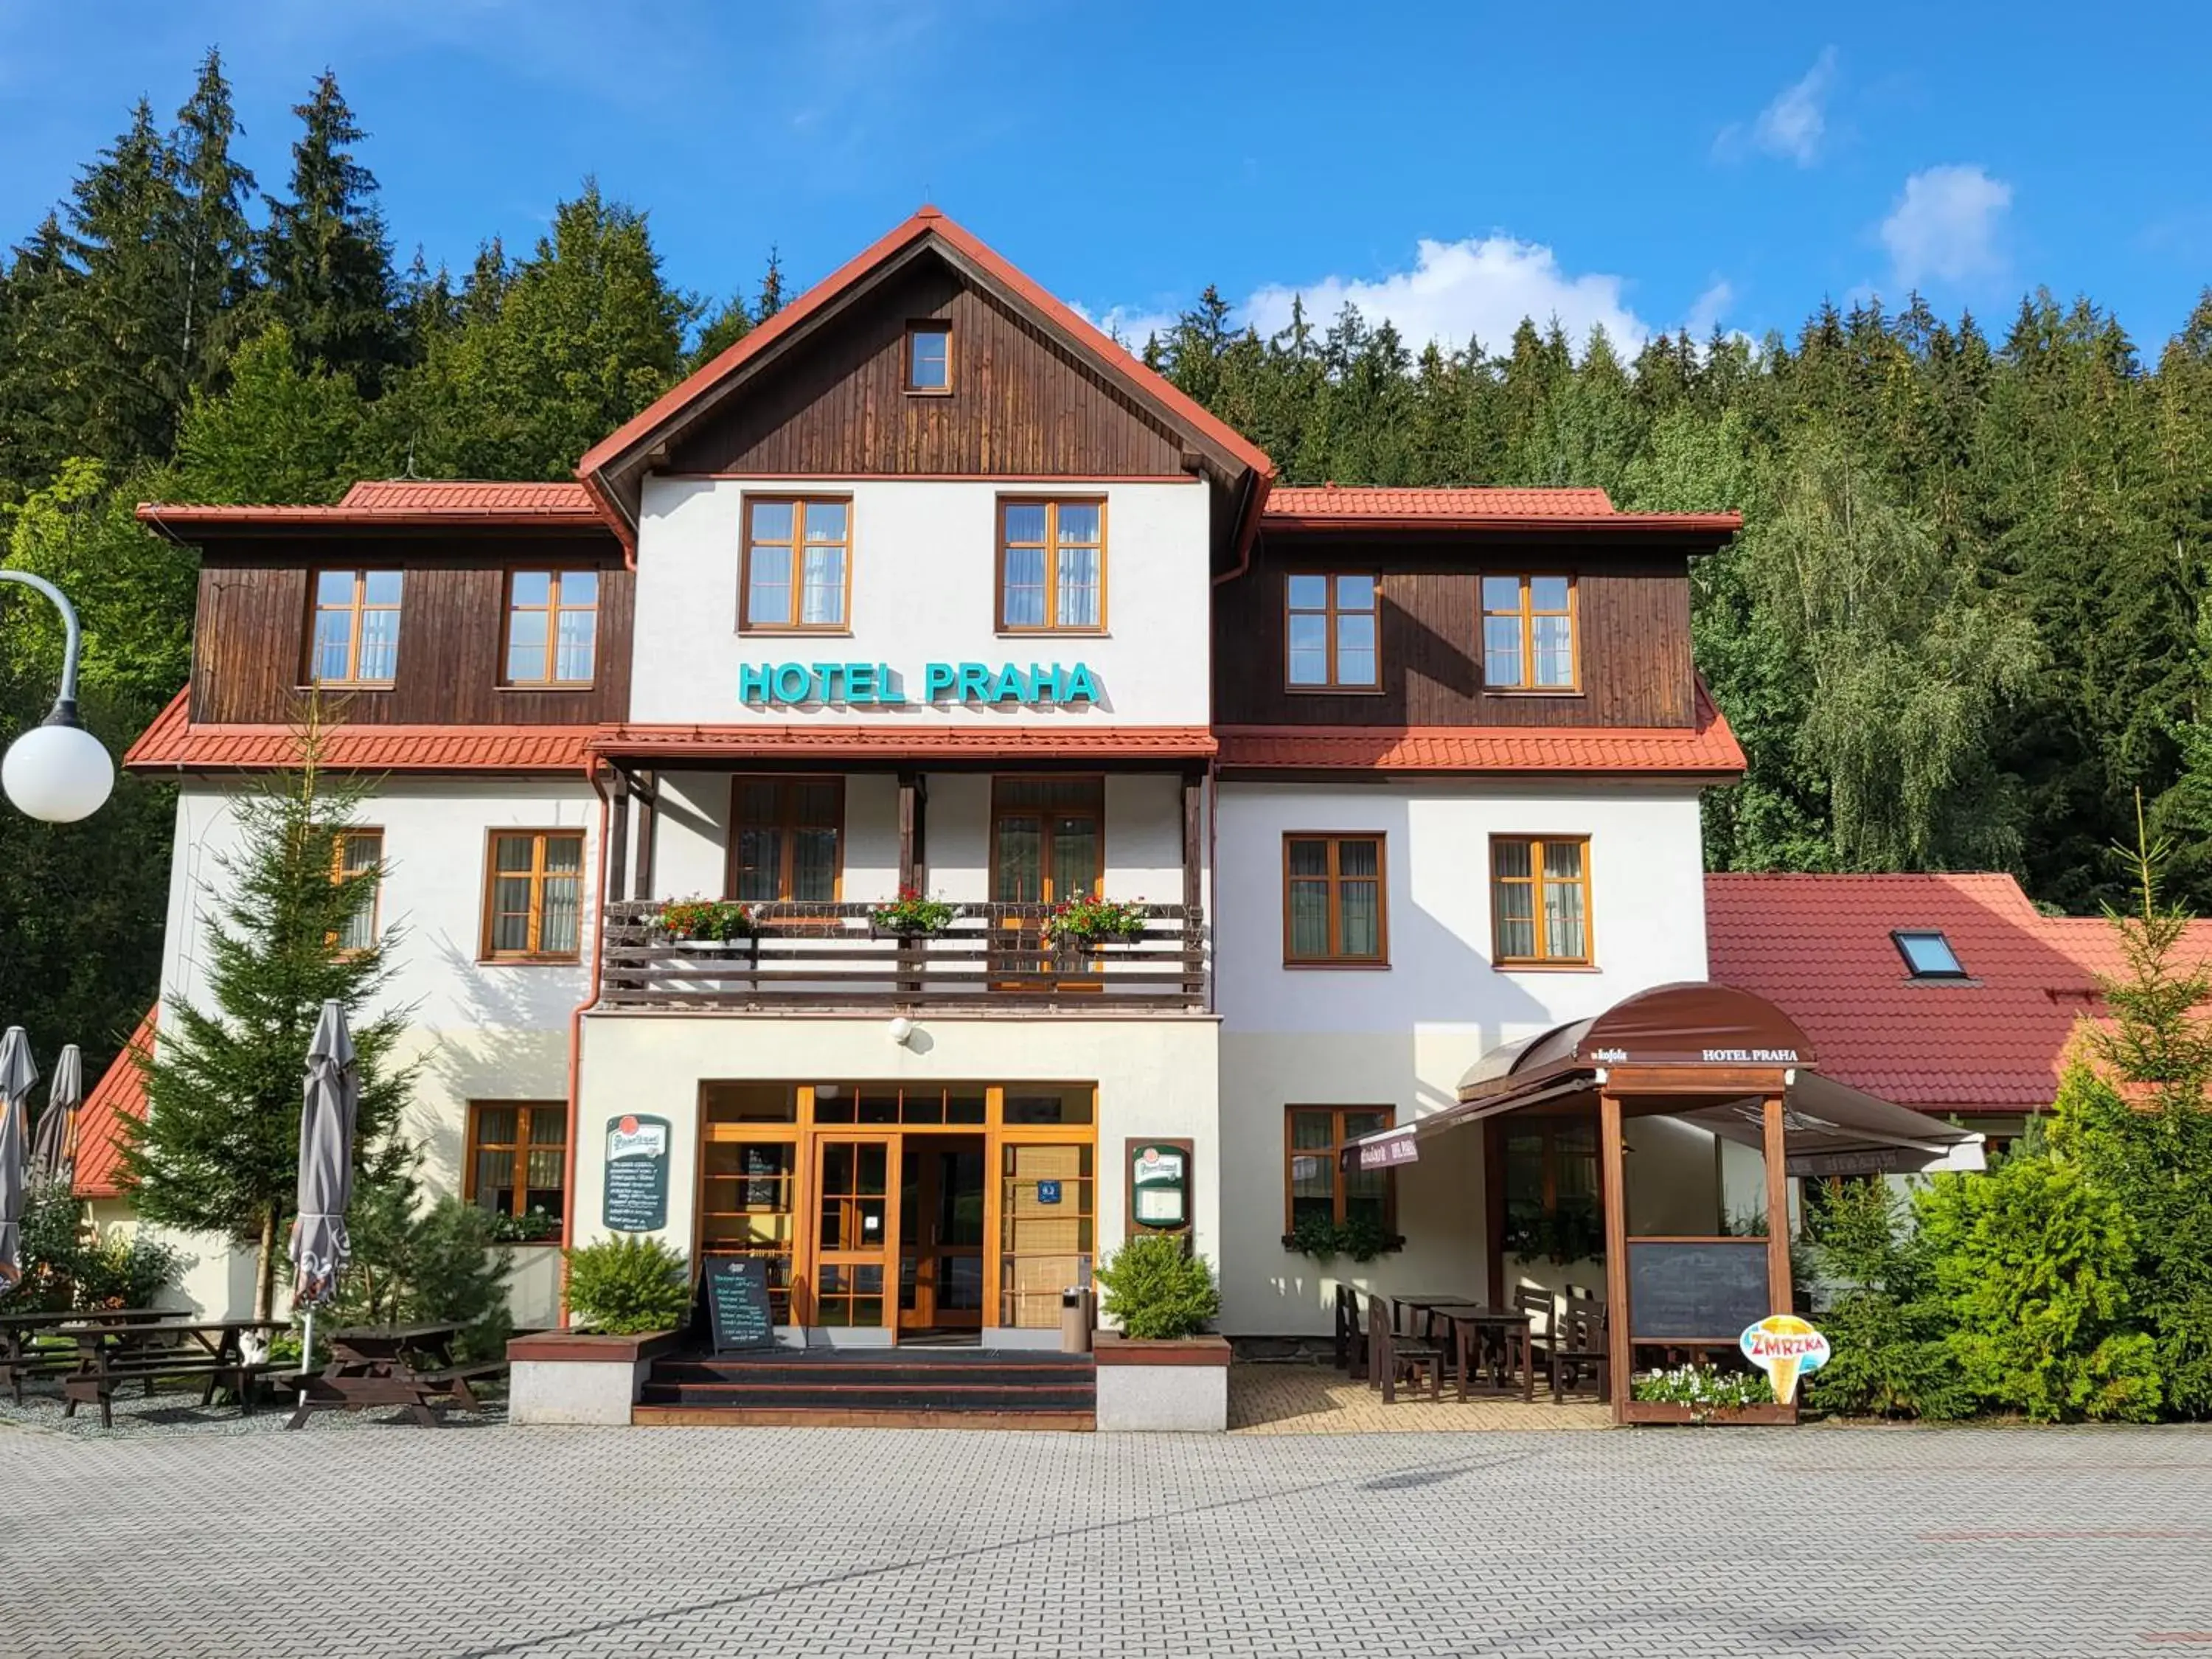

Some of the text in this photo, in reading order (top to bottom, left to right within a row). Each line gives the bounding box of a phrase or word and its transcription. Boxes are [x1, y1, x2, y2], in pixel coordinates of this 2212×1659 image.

[739, 662, 1099, 704] HOTEL PRAHA
[1702, 1049, 1798, 1062] HOTEL PRAHA
[1751, 1334, 1824, 1355] ZMRZKA
